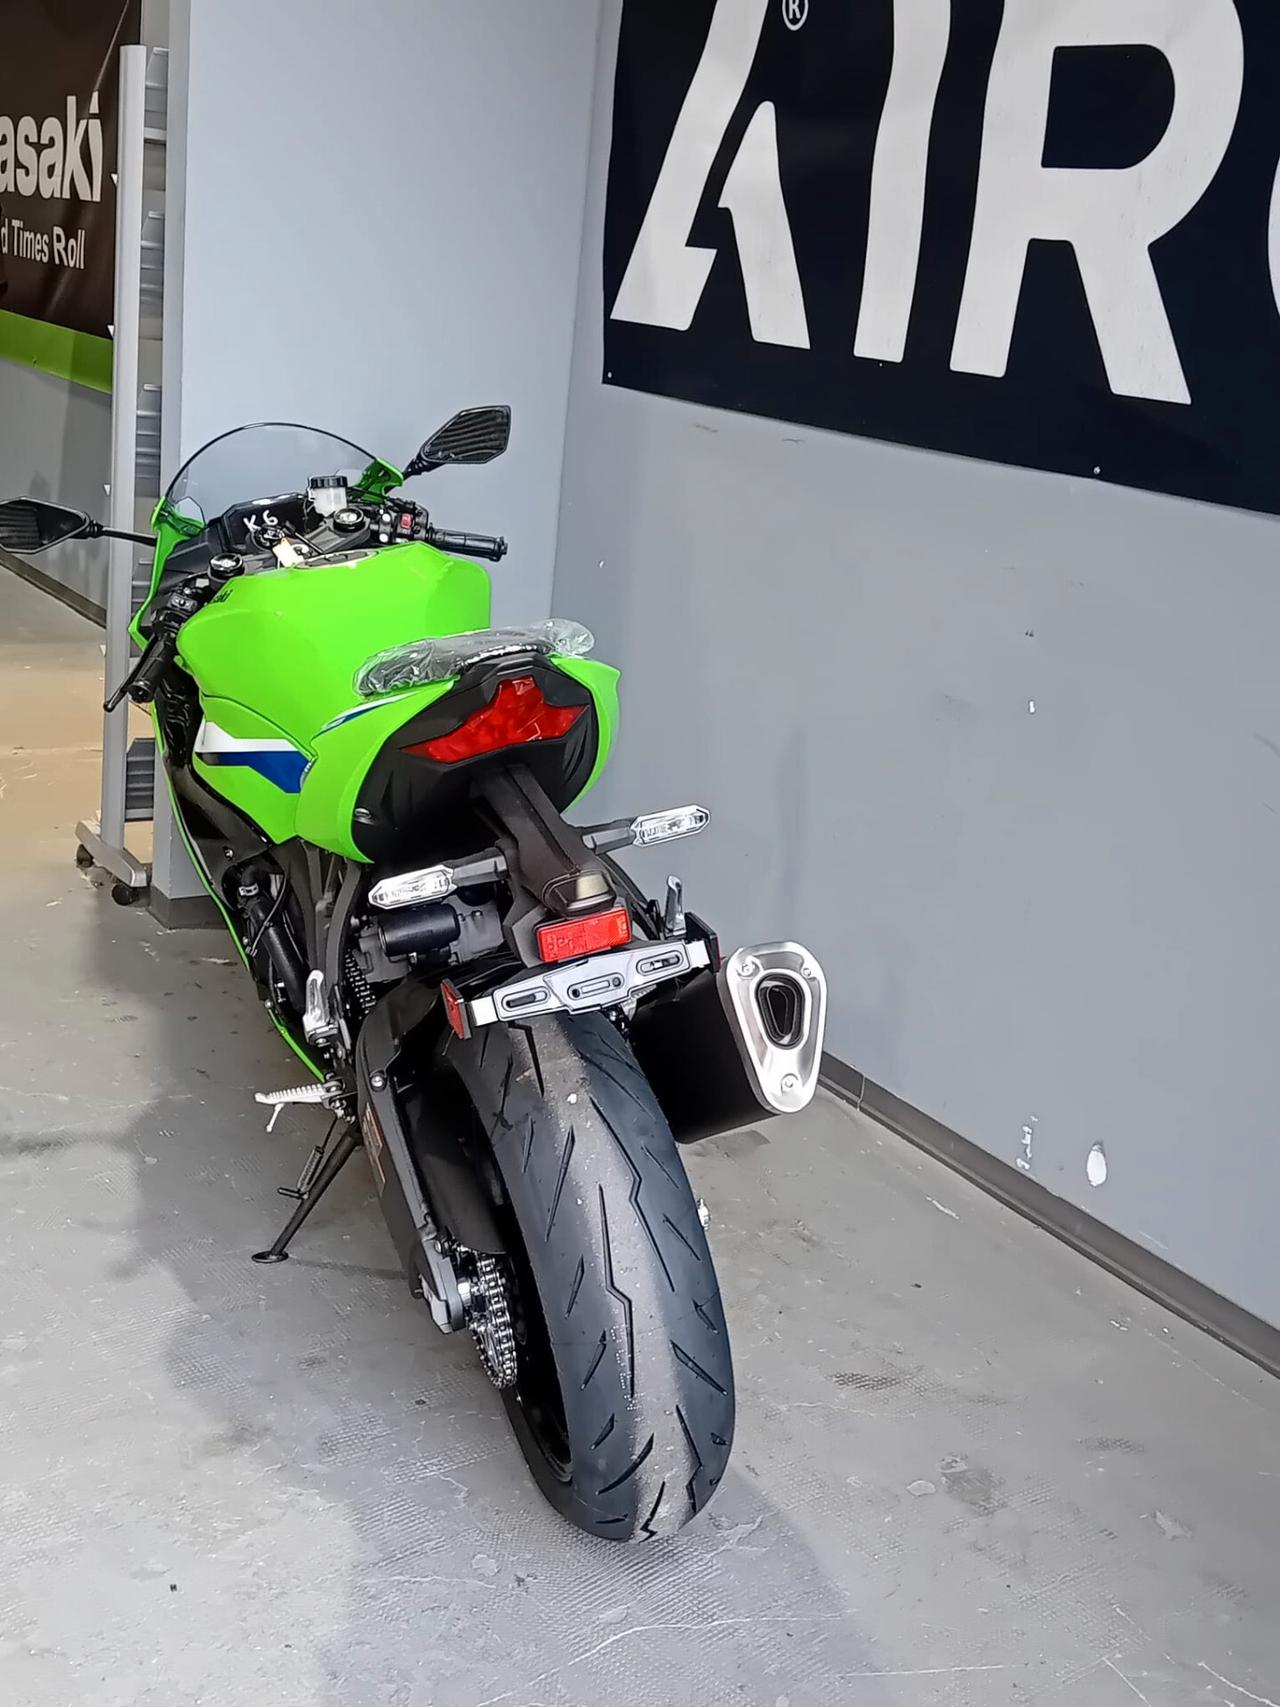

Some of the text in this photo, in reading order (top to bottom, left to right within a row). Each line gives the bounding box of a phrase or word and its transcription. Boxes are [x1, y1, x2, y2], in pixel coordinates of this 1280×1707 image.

[12, 219, 49, 263] Times
[53, 225, 86, 269] Roll
[610, 0, 1280, 405] AIR
